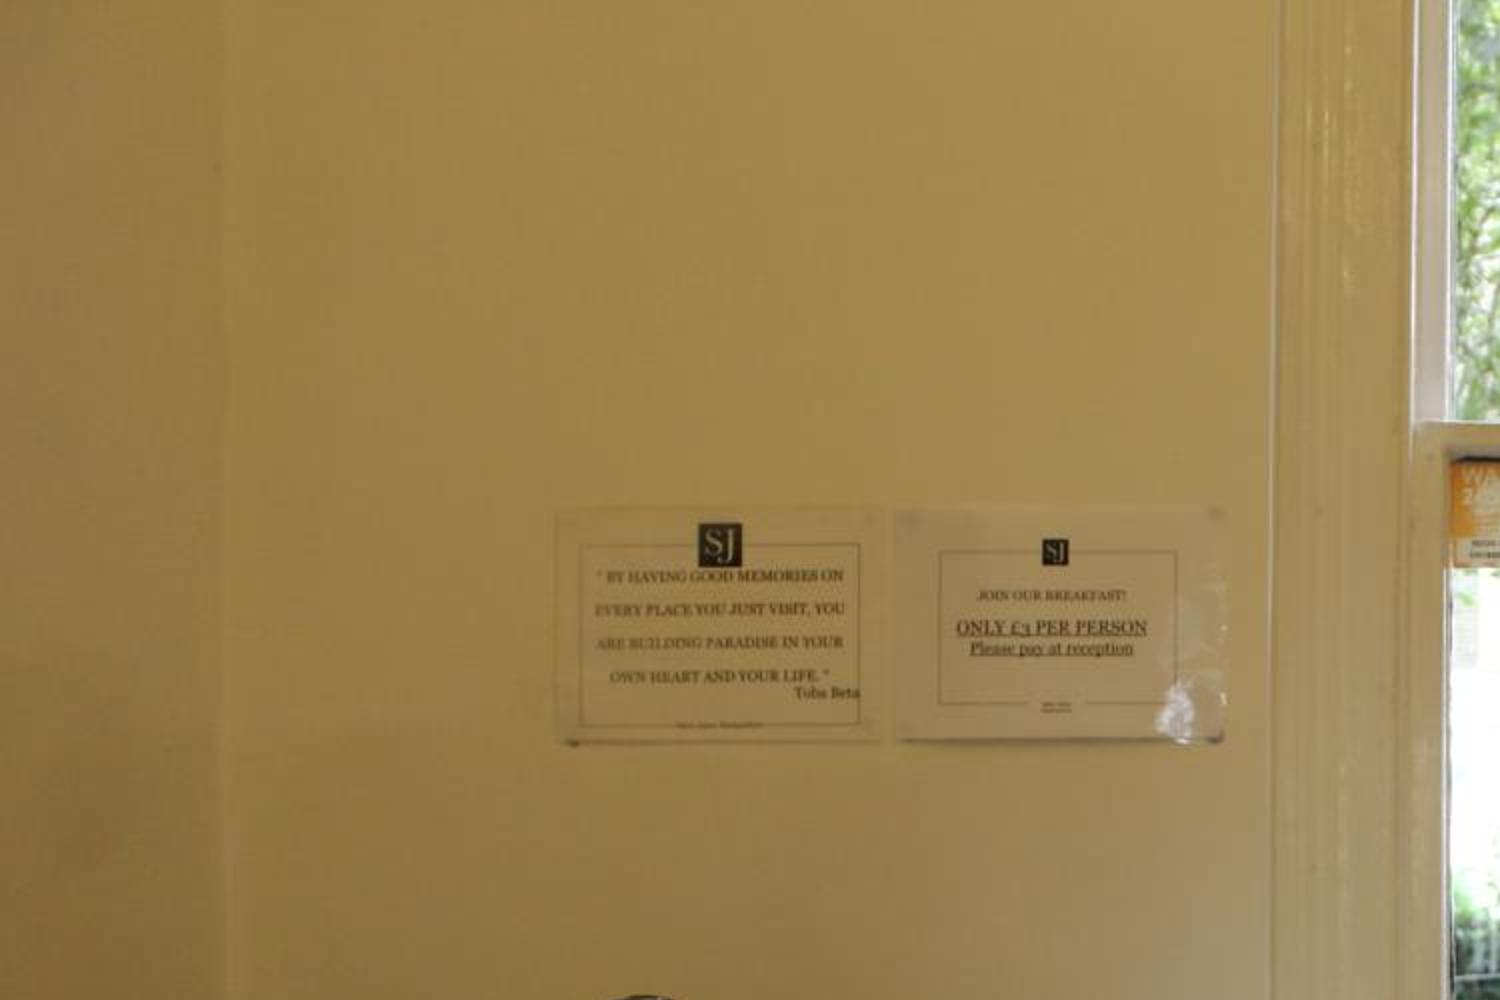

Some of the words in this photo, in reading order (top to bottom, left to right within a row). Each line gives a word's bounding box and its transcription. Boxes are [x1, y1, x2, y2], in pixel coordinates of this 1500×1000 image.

[705, 528, 735, 563] SJ
[628, 569, 686, 584] HAVING
[689, 569, 734, 584] GOOD
[737, 569, 818, 584] MEMORIES
[821, 569, 844, 584] ON
[976, 590, 1009, 602] JOIN
[1012, 590, 1041, 602] OUR
[595, 603, 642, 617] EVERY
[645, 603, 692, 617] PLACE
[694, 603, 727, 617] YOU
[729, 603, 764, 617] JUST
[814, 603, 845, 617] YOU
[956, 619, 1005, 637] ONLY
[1035, 619, 1070, 637] PER
[1075, 619, 1149, 637] PERSON
[595, 635, 625, 650] ARE
[628, 635, 702, 650] BUILDING
[705, 635, 779, 650] PARADISE
[782, 635, 799, 650] IN
[802, 635, 844, 650] YOUR
[969, 641, 1013, 657] Please
[1018, 643, 1043, 659] pay
[1048, 642, 1063, 657] at
[1066, 642, 1135, 659] reception
[609, 669, 646, 684] OWN
[650, 669, 701, 684] HEART
[703, 669, 736, 684] AND
[738, 669, 779, 684] YOUR
[830, 686, 862, 701] Beta
